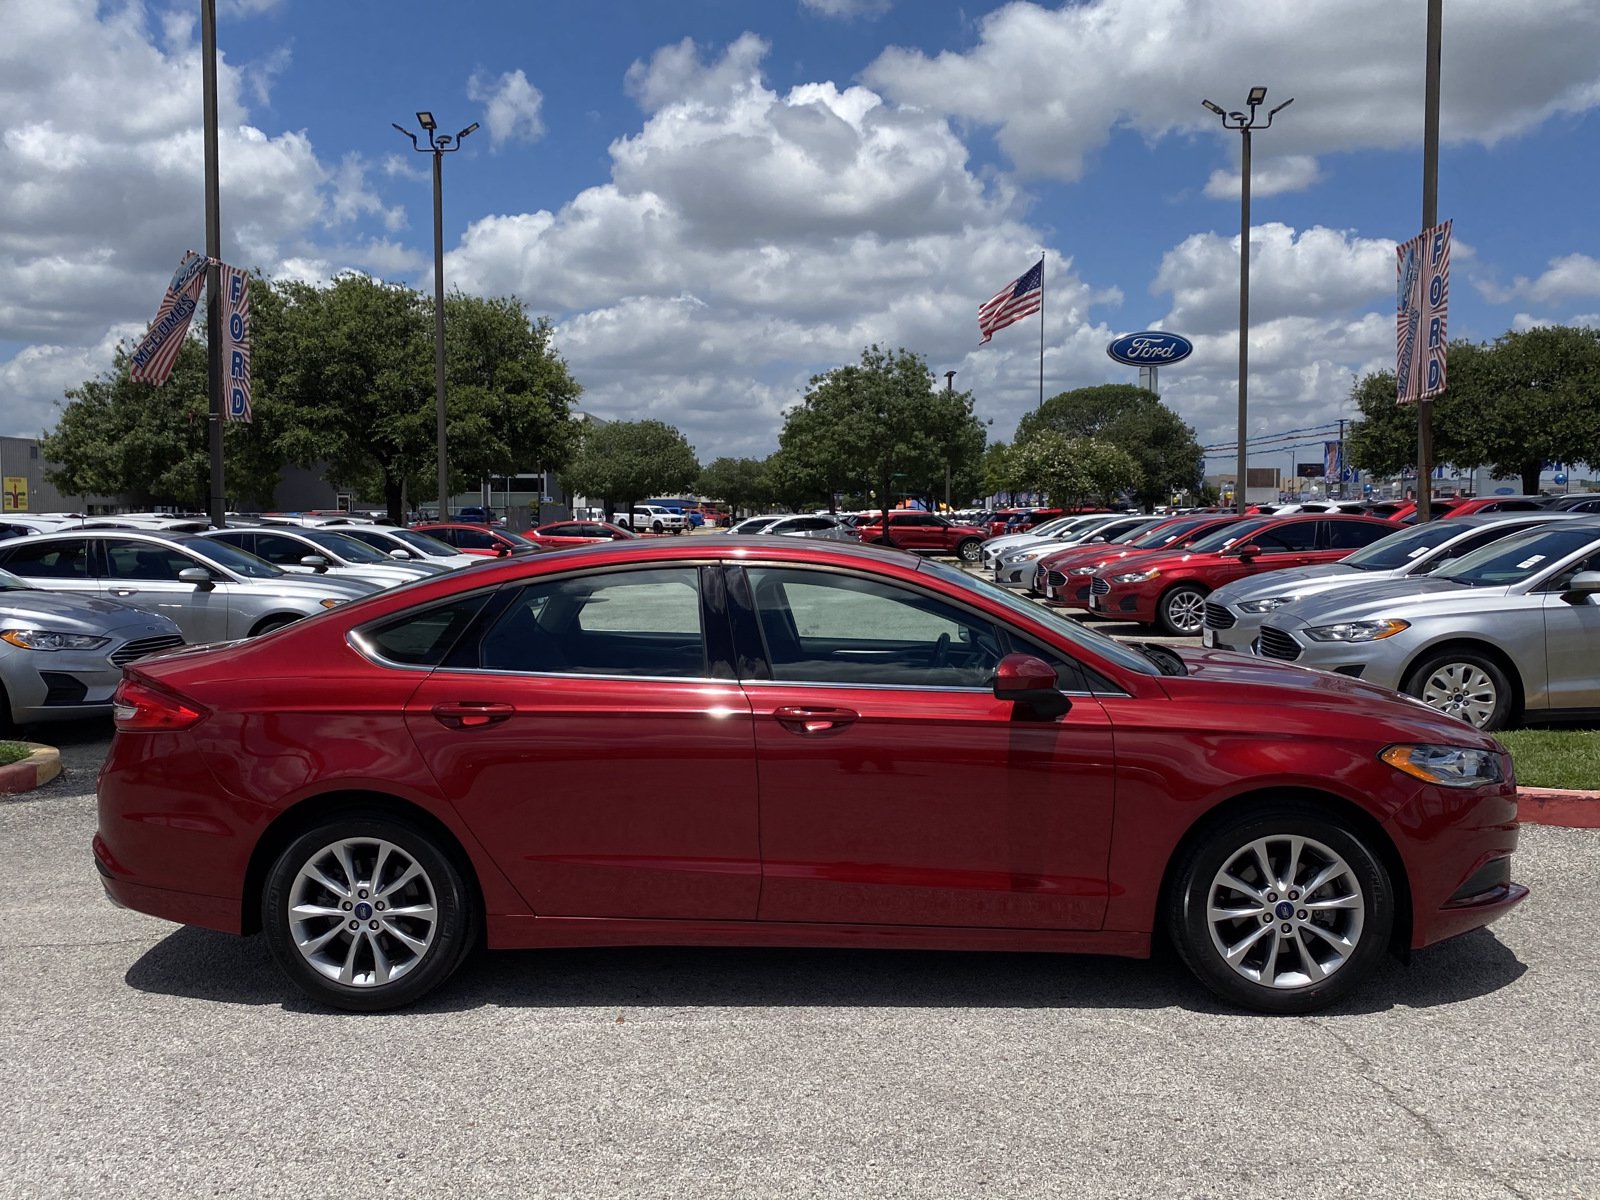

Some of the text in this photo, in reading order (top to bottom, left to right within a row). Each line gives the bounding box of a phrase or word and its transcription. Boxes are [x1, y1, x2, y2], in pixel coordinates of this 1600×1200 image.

[230, 275, 246, 416] FORD
[1127, 337, 1176, 358] Ford
[1428, 231, 1444, 391] FORD
